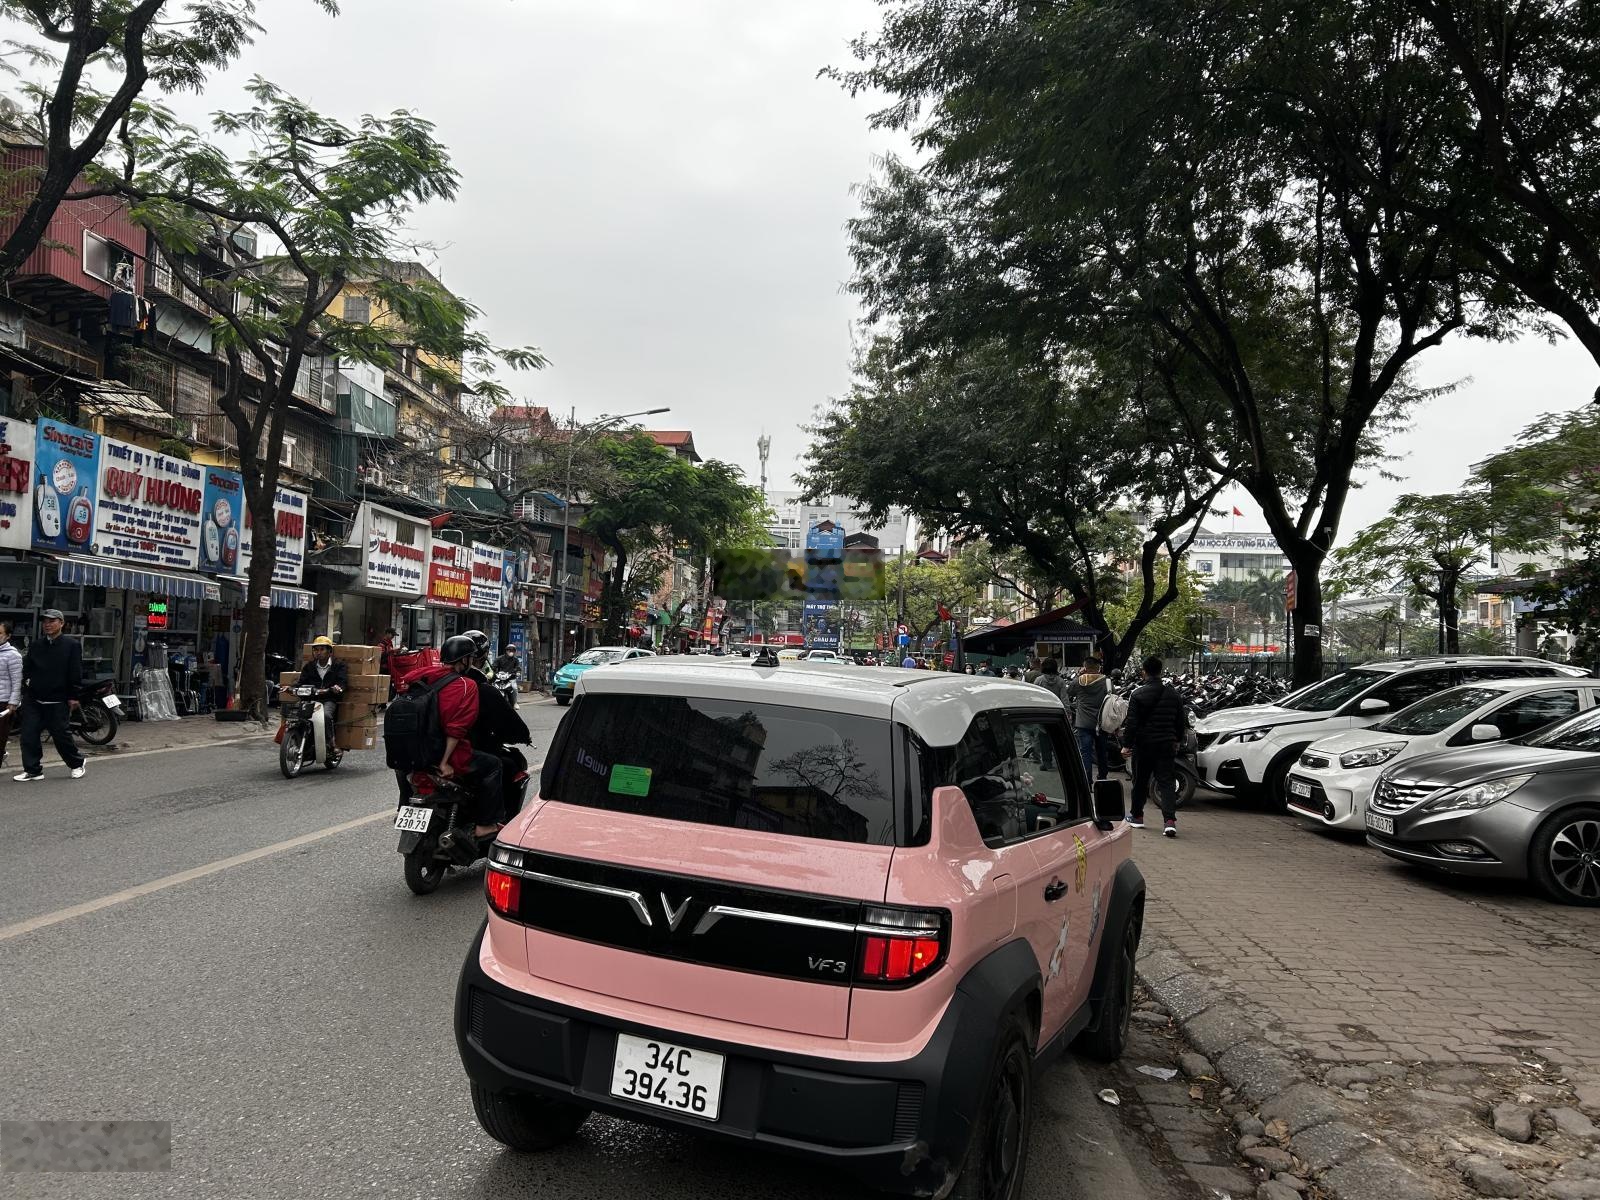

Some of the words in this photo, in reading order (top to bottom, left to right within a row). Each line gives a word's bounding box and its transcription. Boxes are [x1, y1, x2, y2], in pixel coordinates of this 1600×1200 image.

[44, 426, 94, 452] Sinocare
[108, 443, 132, 461] THIẾT
[134, 452, 143, 465] BỊ
[146, 455, 151, 466] Y
[154, 456, 164, 470] TẾ
[106, 467, 143, 499] QUÝ
[146, 477, 202, 514] HƯƠNG
[1206, 539, 1220, 548] HỌC
[397, 818, 427, 830] 230.79
[403, 808, 426, 820] 29-E1
[645, 1043, 691, 1076] 34C
[623, 1069, 707, 1112] 394.36
